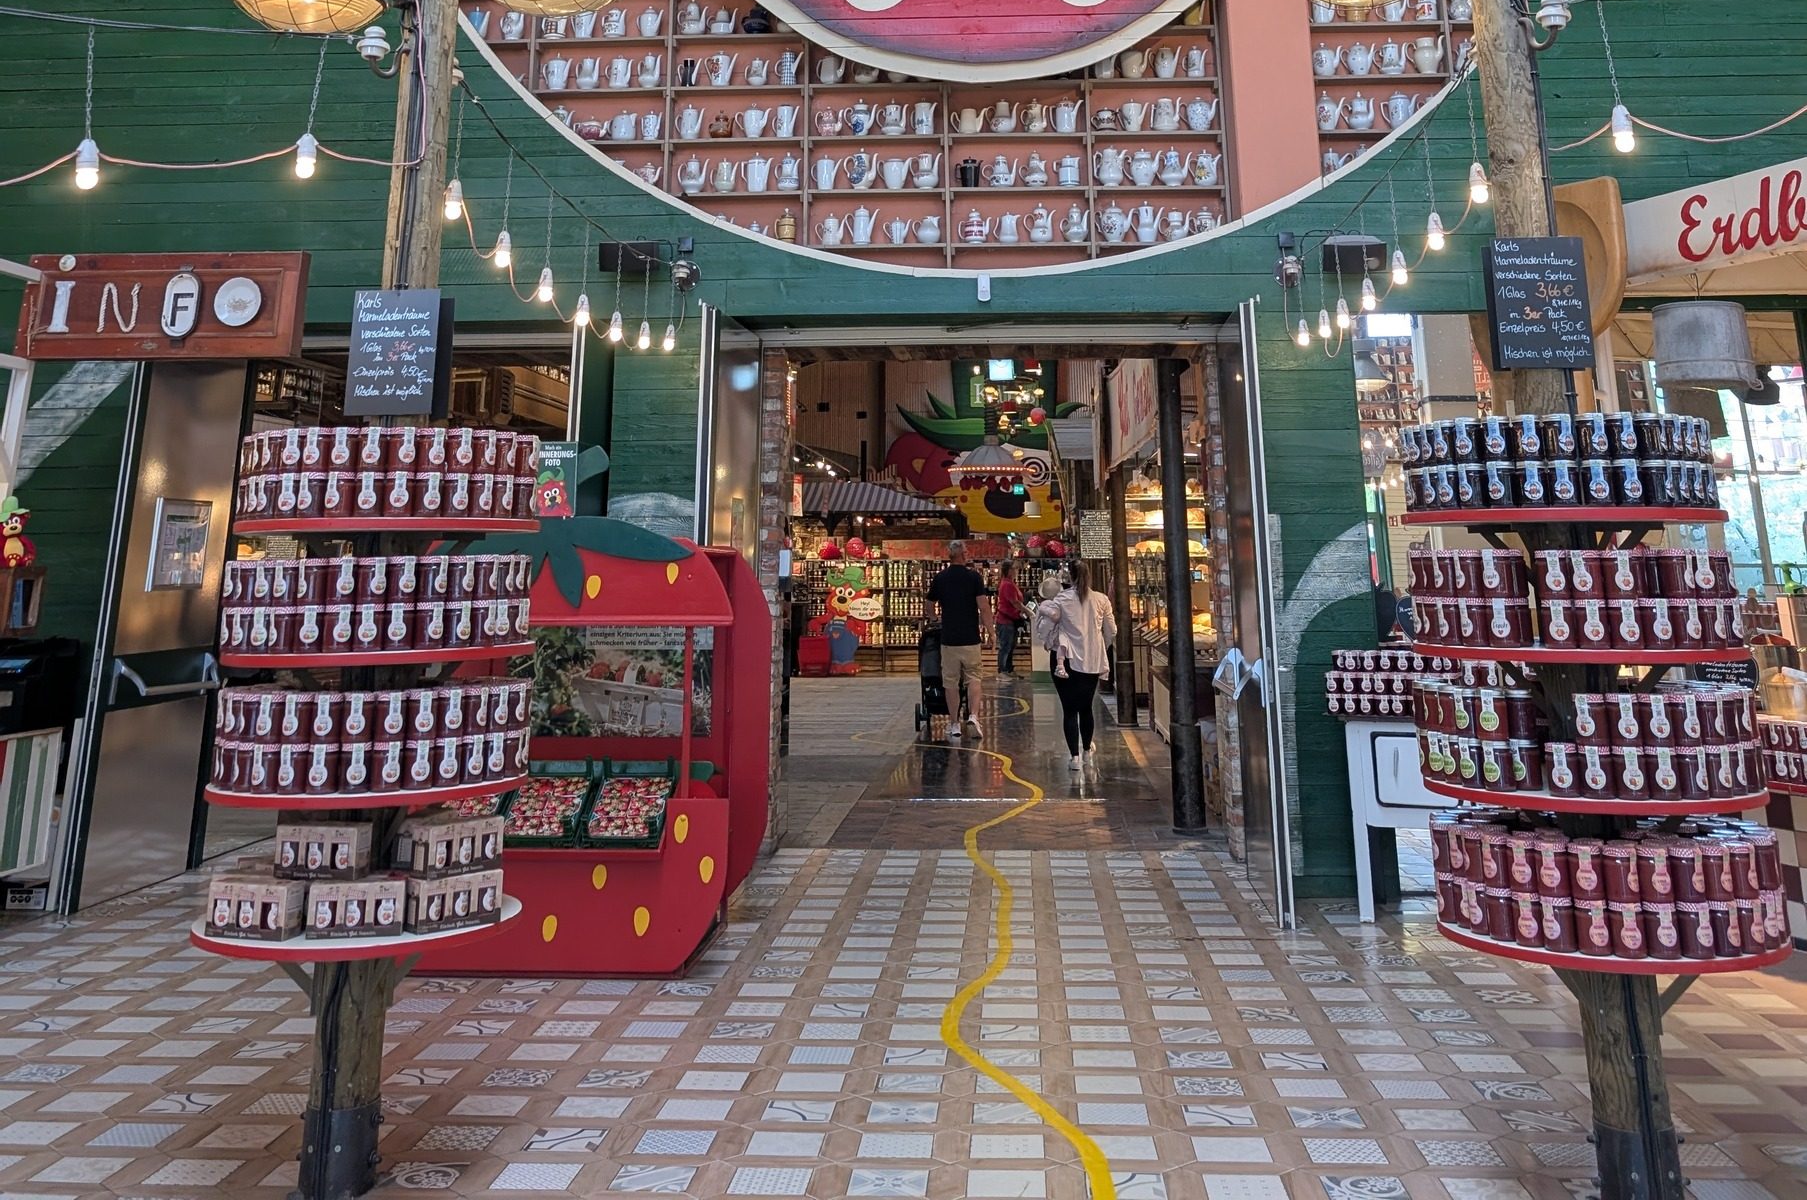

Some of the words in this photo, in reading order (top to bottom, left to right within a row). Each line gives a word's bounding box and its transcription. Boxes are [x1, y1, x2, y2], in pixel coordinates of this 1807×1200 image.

[1494, 240, 1519, 252] Karls
[1495, 252, 1577, 266] Marmeladenträume
[1495, 270, 1540, 279] verschiedene
[1545, 270, 1576, 280] Sorten
[47, 255, 262, 337] INFO
[357, 292, 382, 309] Karls
[358, 307, 430, 322] Marmeladenträume
[1523, 306, 1543, 320] 3er
[1543, 307, 1567, 318] Pack
[362, 327, 405, 339] verschiedene
[408, 324, 431, 336] Sorten
[1500, 322, 1546, 335] Einzelpreis
[386, 352, 400, 362] 3er
[401, 351, 417, 363] Pack
[1504, 345, 1539, 359] Mischen
[1542, 348, 1552, 358] ist
[1556, 347, 1592, 362] möglich
[353, 366, 394, 380] Einzelpreis
[354, 385, 379, 397] Mischen
[382, 384, 395, 396] ist
[396, 384, 423, 400] möglich
[540, 450, 576, 458] INNERUNGS-
